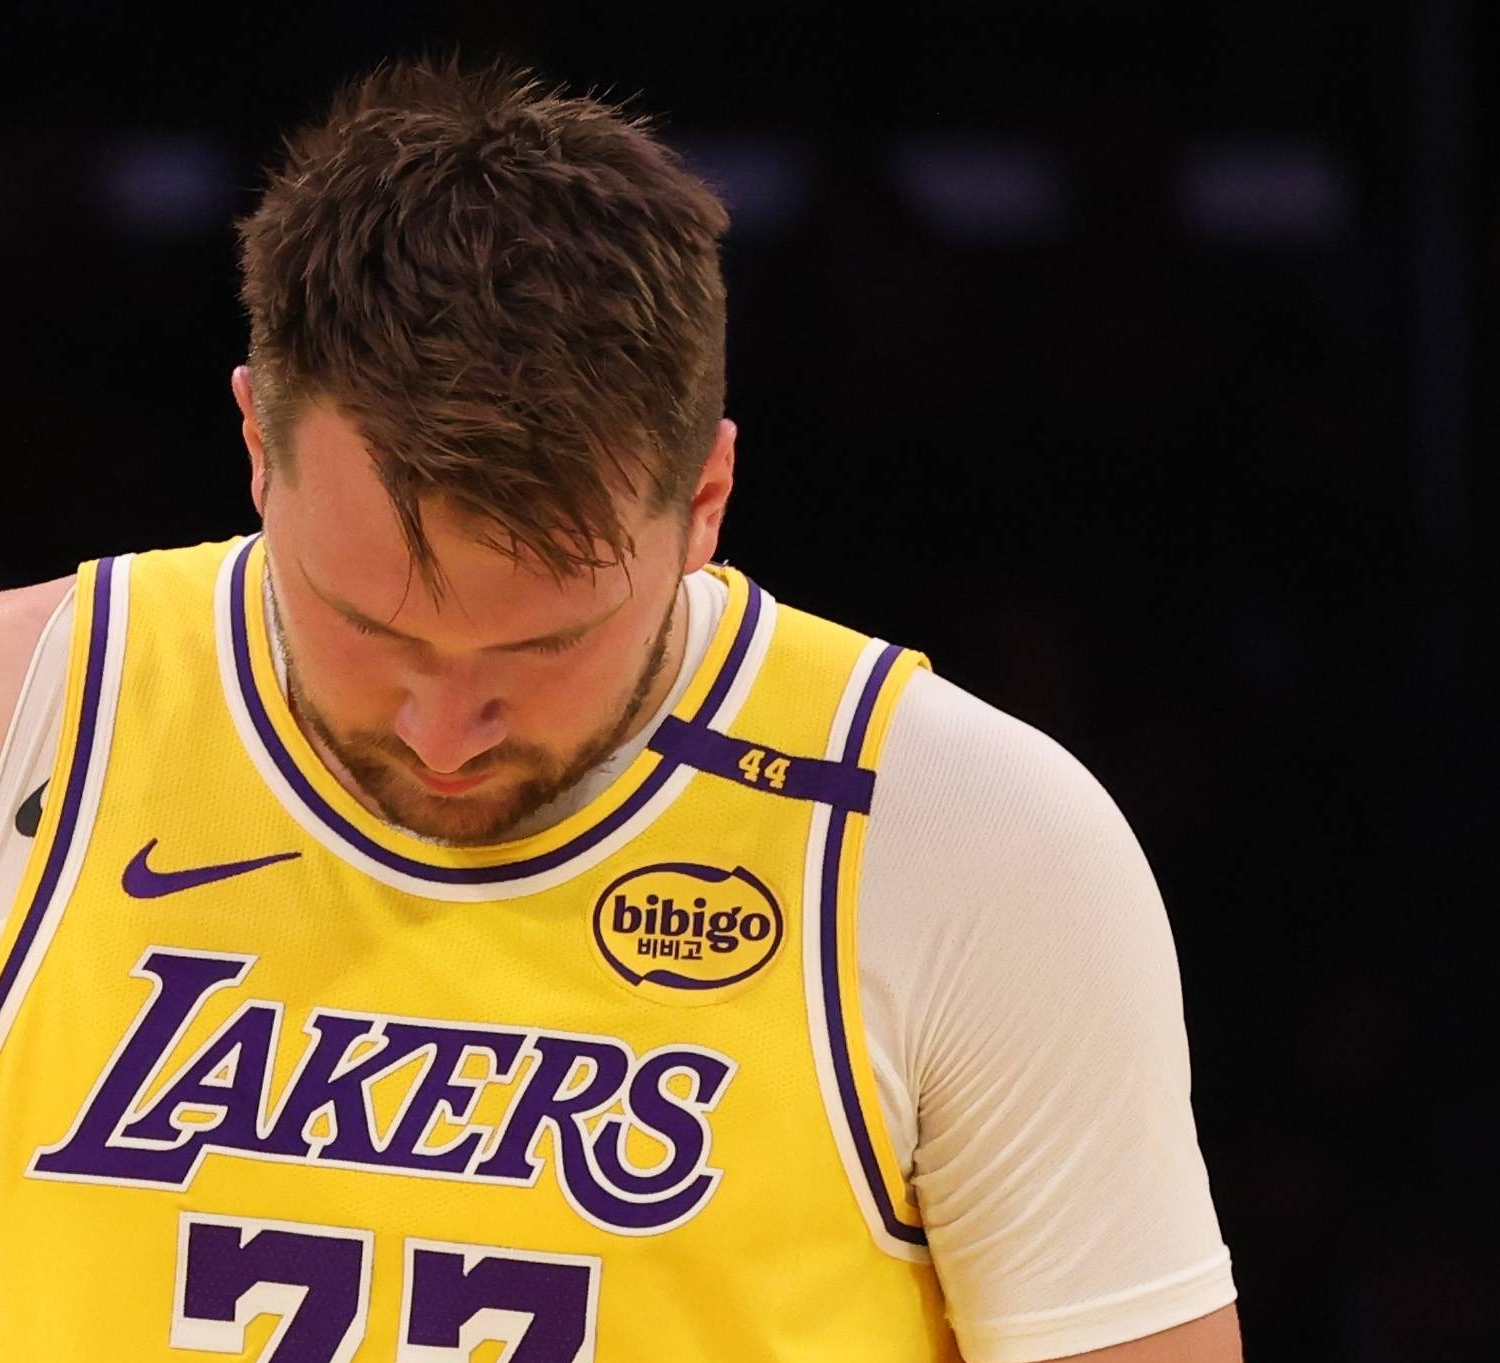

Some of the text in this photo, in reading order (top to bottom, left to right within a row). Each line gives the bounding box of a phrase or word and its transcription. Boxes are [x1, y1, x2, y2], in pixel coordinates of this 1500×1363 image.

[738, 748, 791, 789] 44
[611, 893, 772, 954] bibigo
[637, 936, 704, 961] 비비고
[24, 945, 741, 1237] LAKERS
